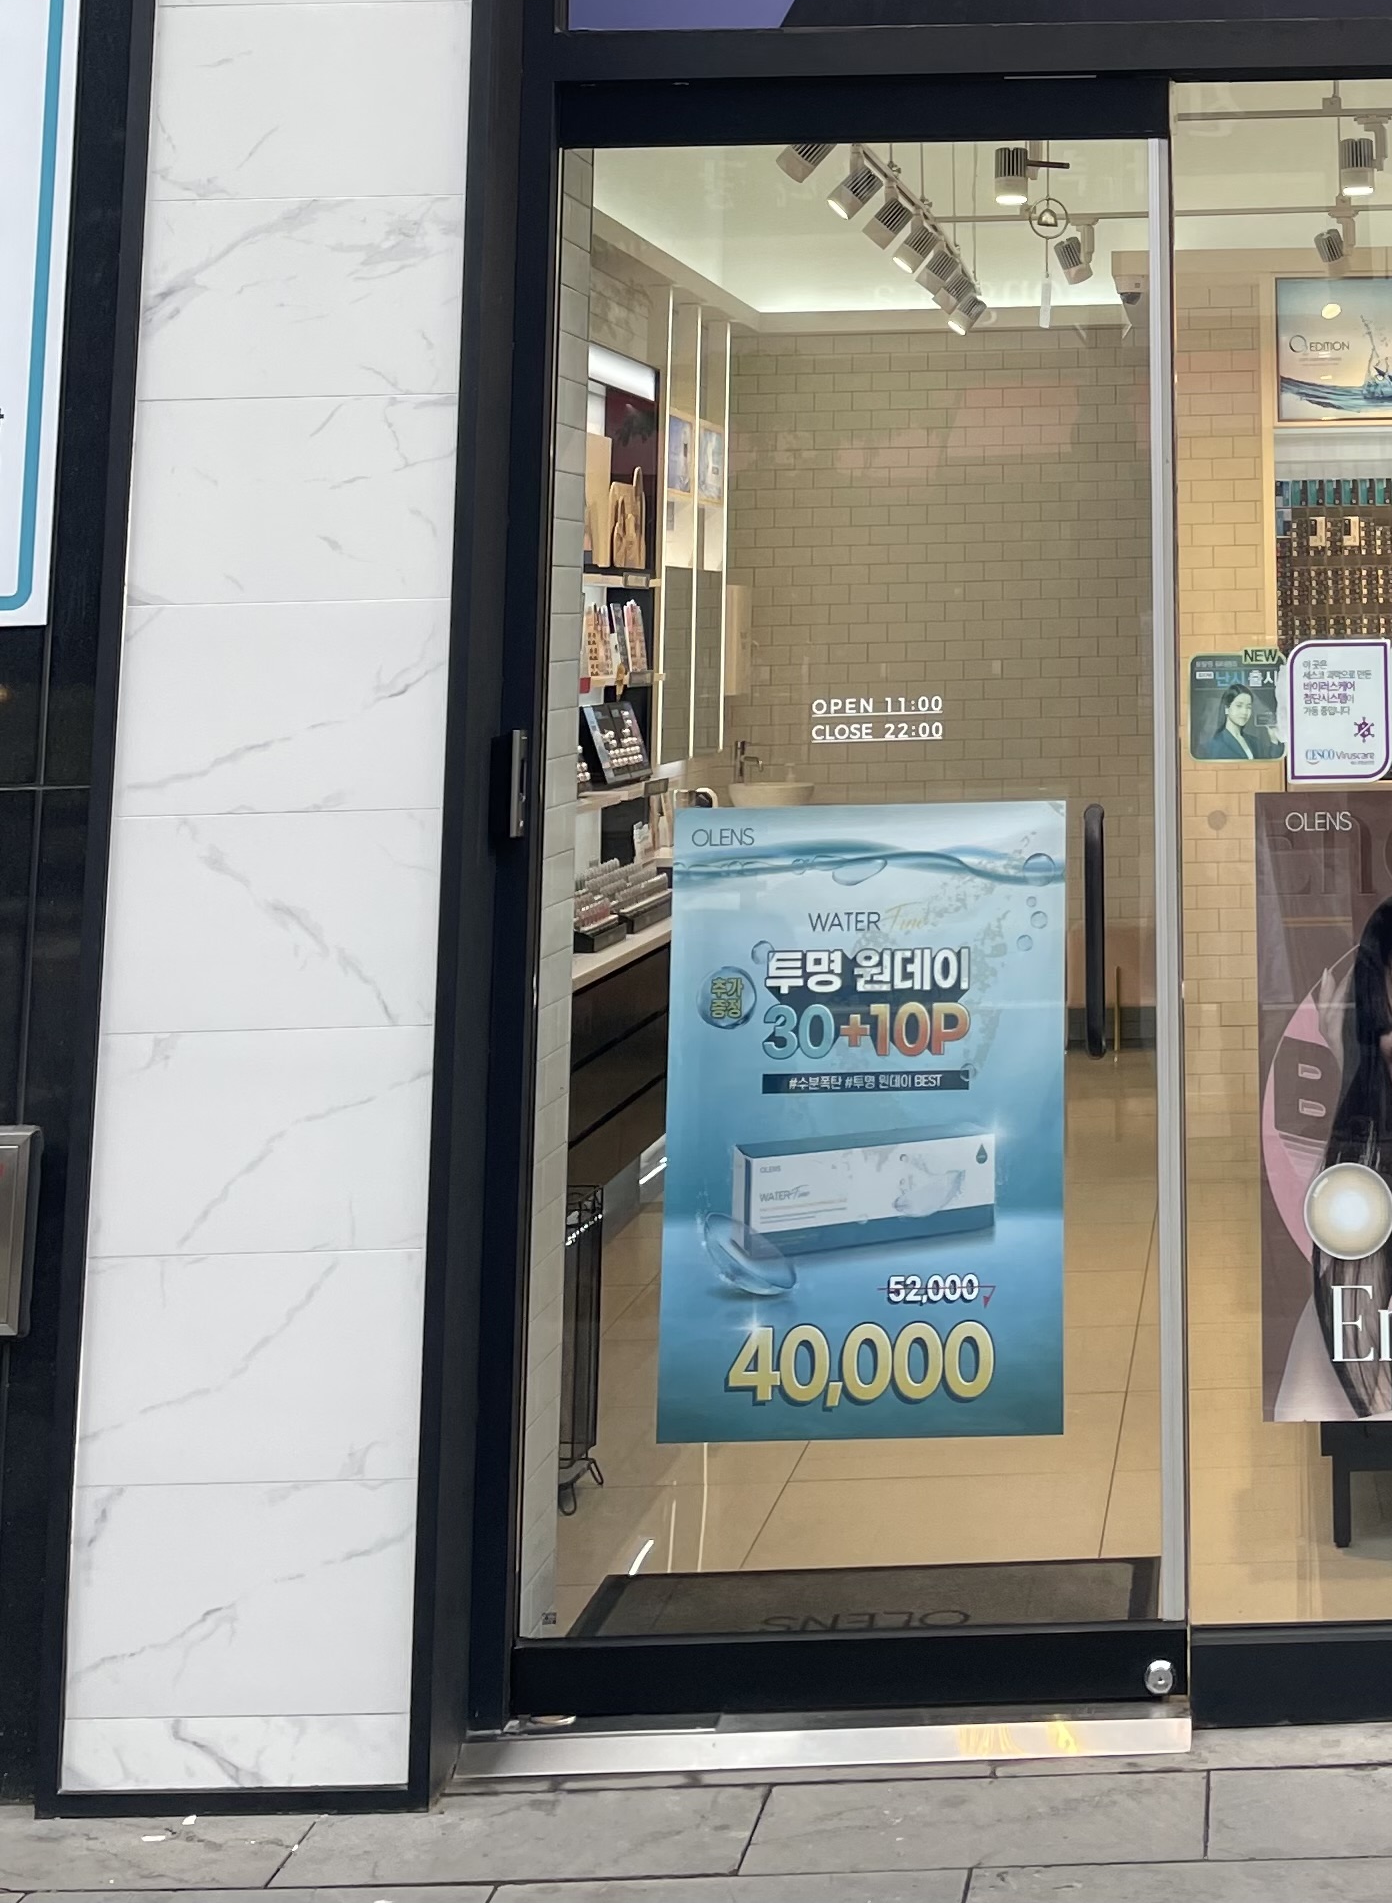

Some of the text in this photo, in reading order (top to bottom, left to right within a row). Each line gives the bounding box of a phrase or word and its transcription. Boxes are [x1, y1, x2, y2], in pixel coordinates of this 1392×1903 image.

[1309, 340, 1350, 352] EDITION
[1243, 648, 1278, 663] NEW
[811, 696, 943, 714] OPEN 11:00
[811, 722, 943, 739] CLOSE 22:00
[1285, 811, 1353, 832] OLENS
[691, 828, 755, 847] OLENS
[808, 911, 881, 932] WATER
[764, 947, 971, 995] 투명 원데이
[710, 977, 744, 998] 추가
[710, 998, 742, 1019] 증정
[762, 1001, 971, 1060] 30+10P
[788, 1073, 942, 1090] #수분폭탄 #투명 원데이 BEST
[887, 1273, 980, 1304] 52,000
[726, 1319, 995, 1411] 40,000
